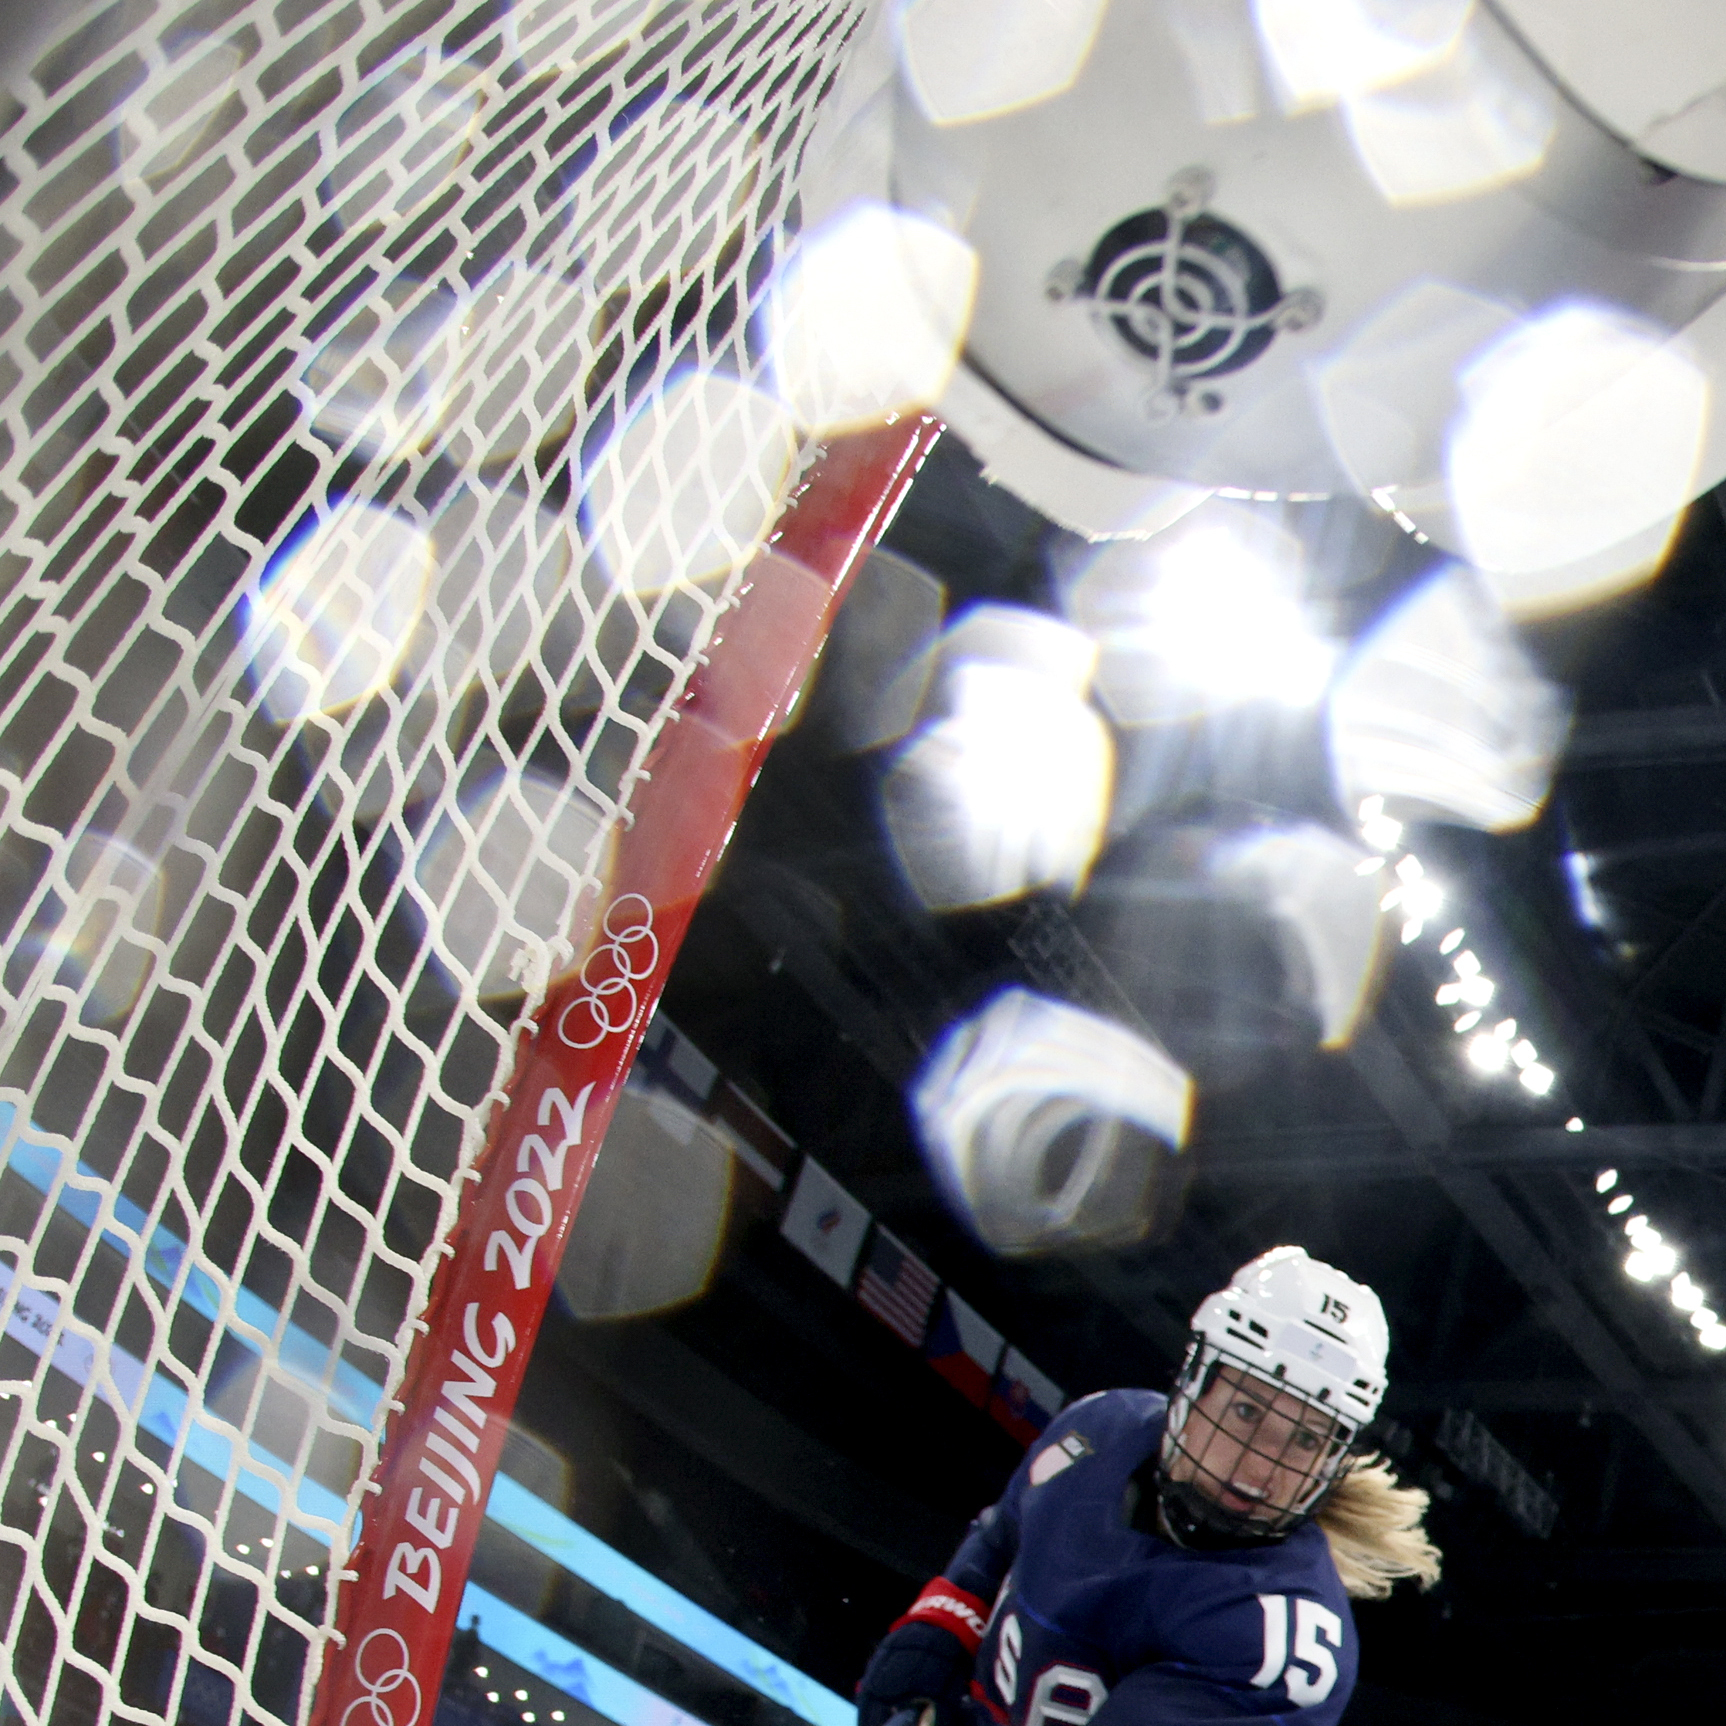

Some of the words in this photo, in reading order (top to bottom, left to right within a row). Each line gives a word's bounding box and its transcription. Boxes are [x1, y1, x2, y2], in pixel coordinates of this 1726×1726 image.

[383, 1303, 517, 1613] BEIJING
[483, 1081, 596, 1291] 2022
[1320, 1293, 1350, 1324] 15
[1251, 1593, 1343, 1708] 15
